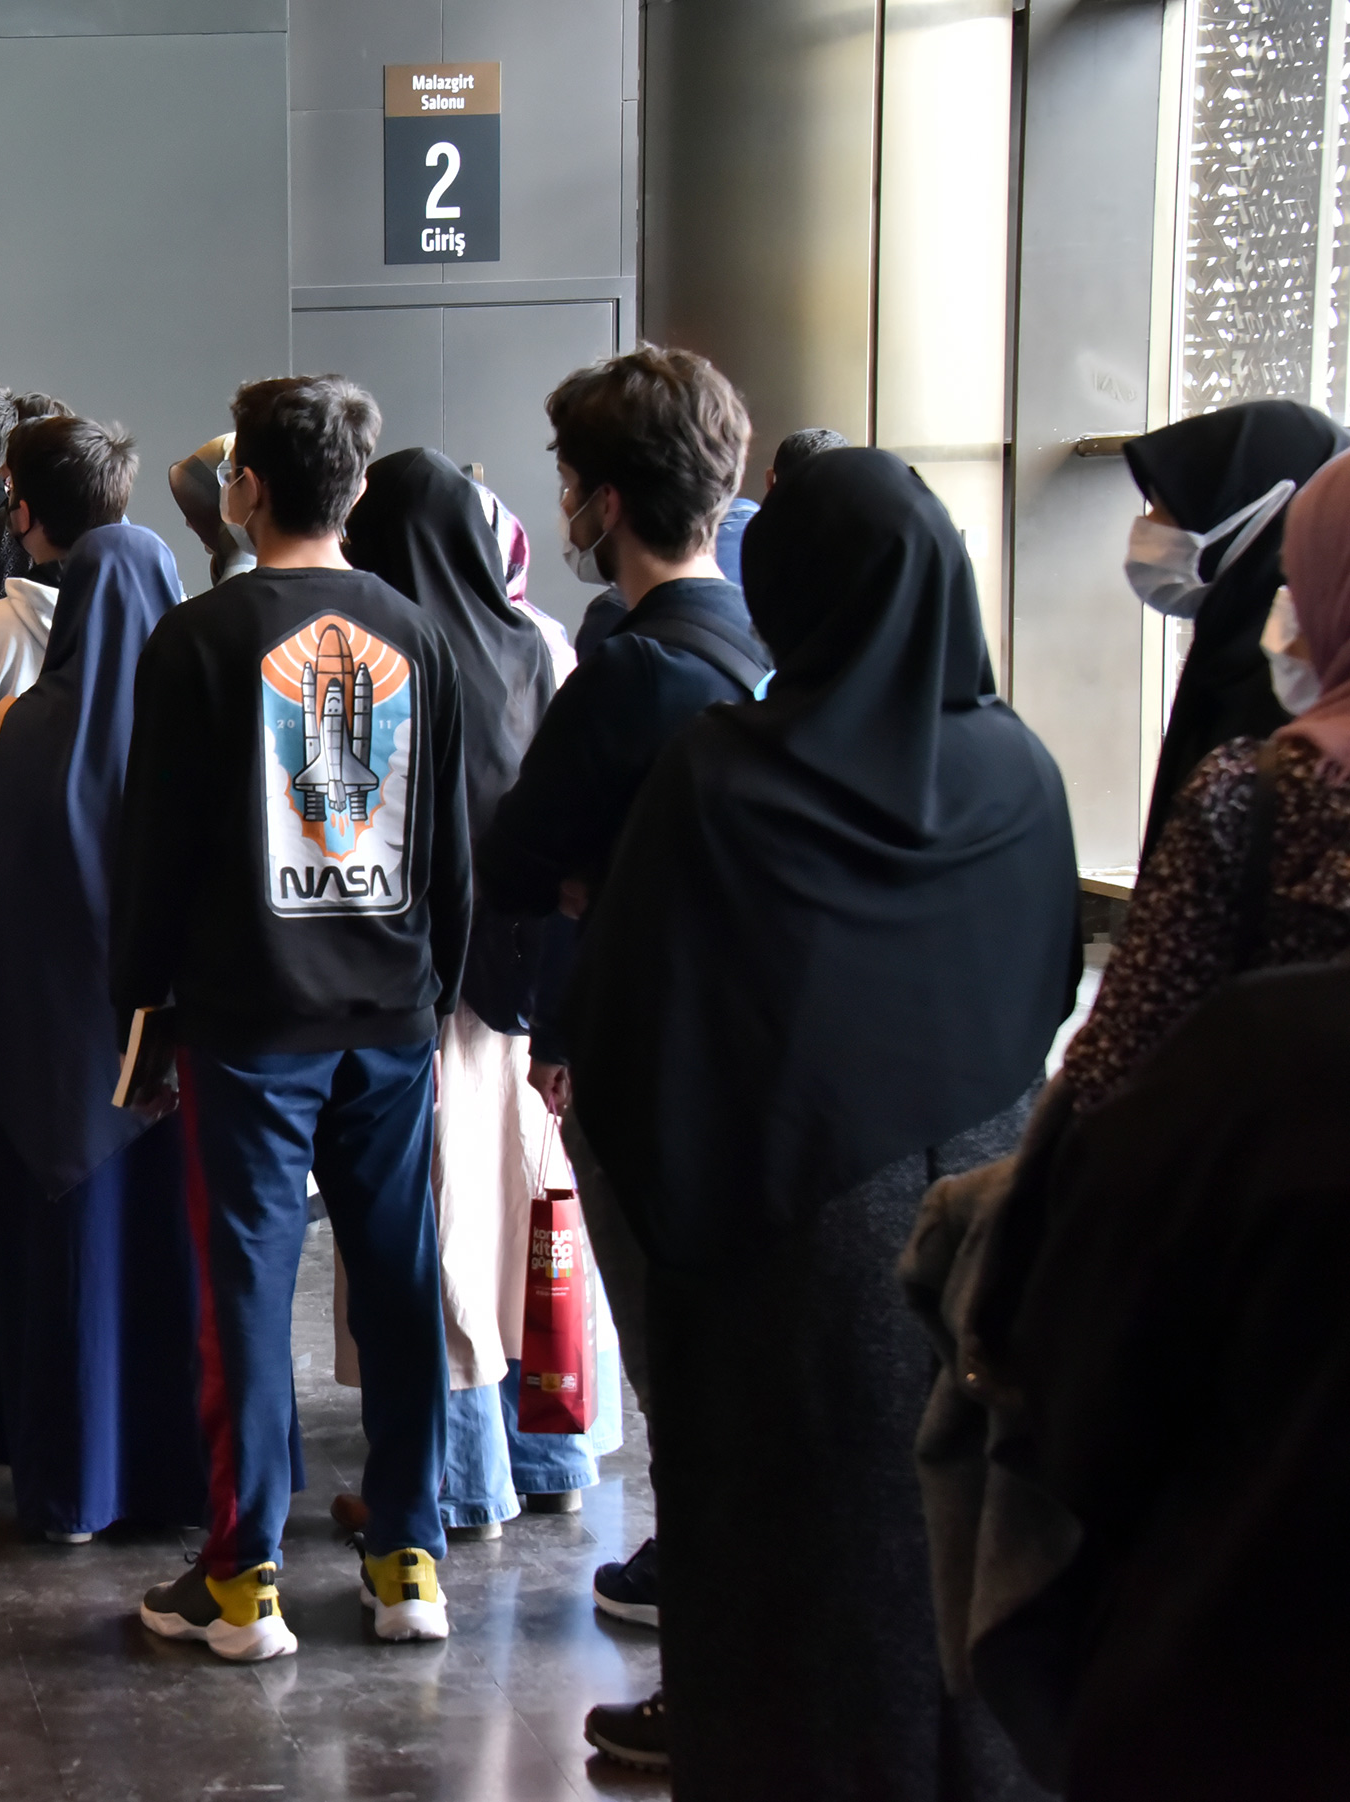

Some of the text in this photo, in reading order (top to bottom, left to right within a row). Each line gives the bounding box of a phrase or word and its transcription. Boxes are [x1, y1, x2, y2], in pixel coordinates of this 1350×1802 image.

[412, 73, 475, 93] Malazgirt
[420, 94, 465, 111] Salonu
[425, 141, 461, 219] 2
[421, 226, 466, 257] Giriş
[280, 865, 392, 899] NASA
